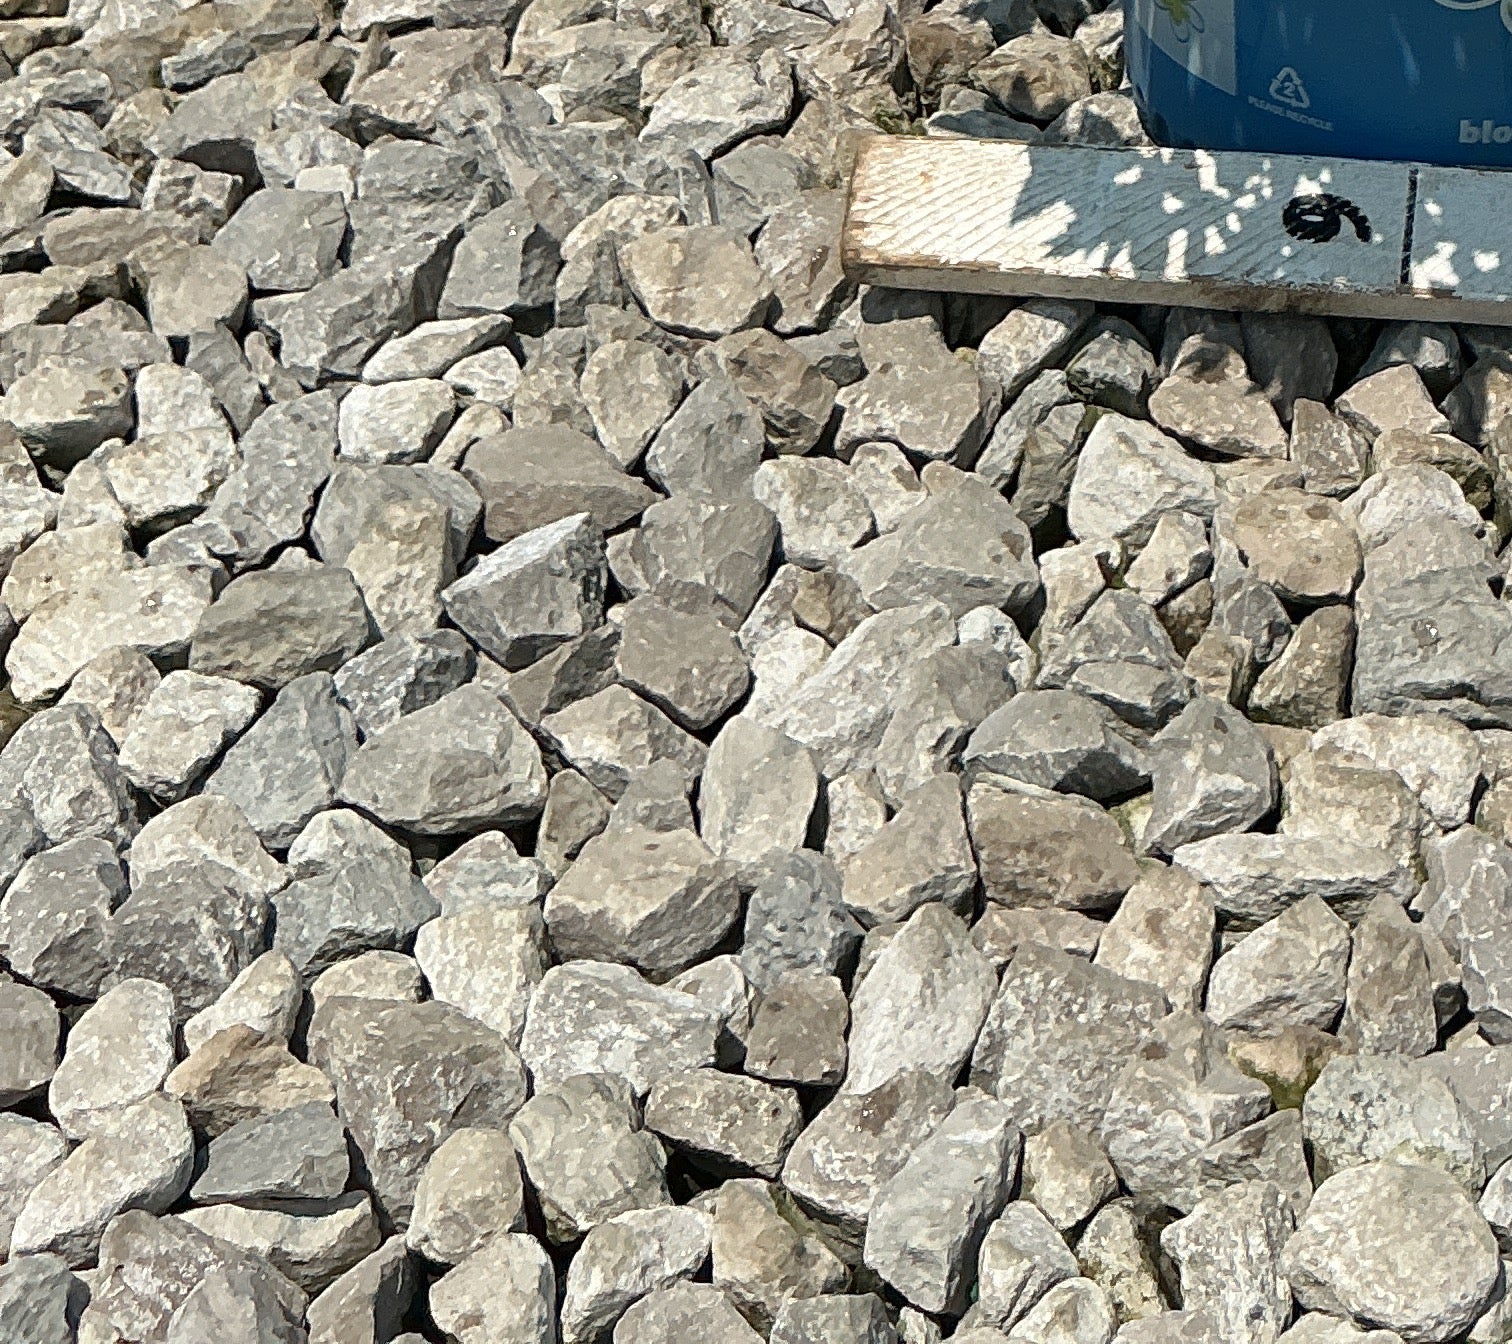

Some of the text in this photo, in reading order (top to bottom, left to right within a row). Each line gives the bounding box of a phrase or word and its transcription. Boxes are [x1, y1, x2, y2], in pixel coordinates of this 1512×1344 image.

[1283, 81, 1296, 97] 2
[1248, 95, 1334, 131] PLEASE RECYCLE
[1282, 193, 1372, 244] 6
